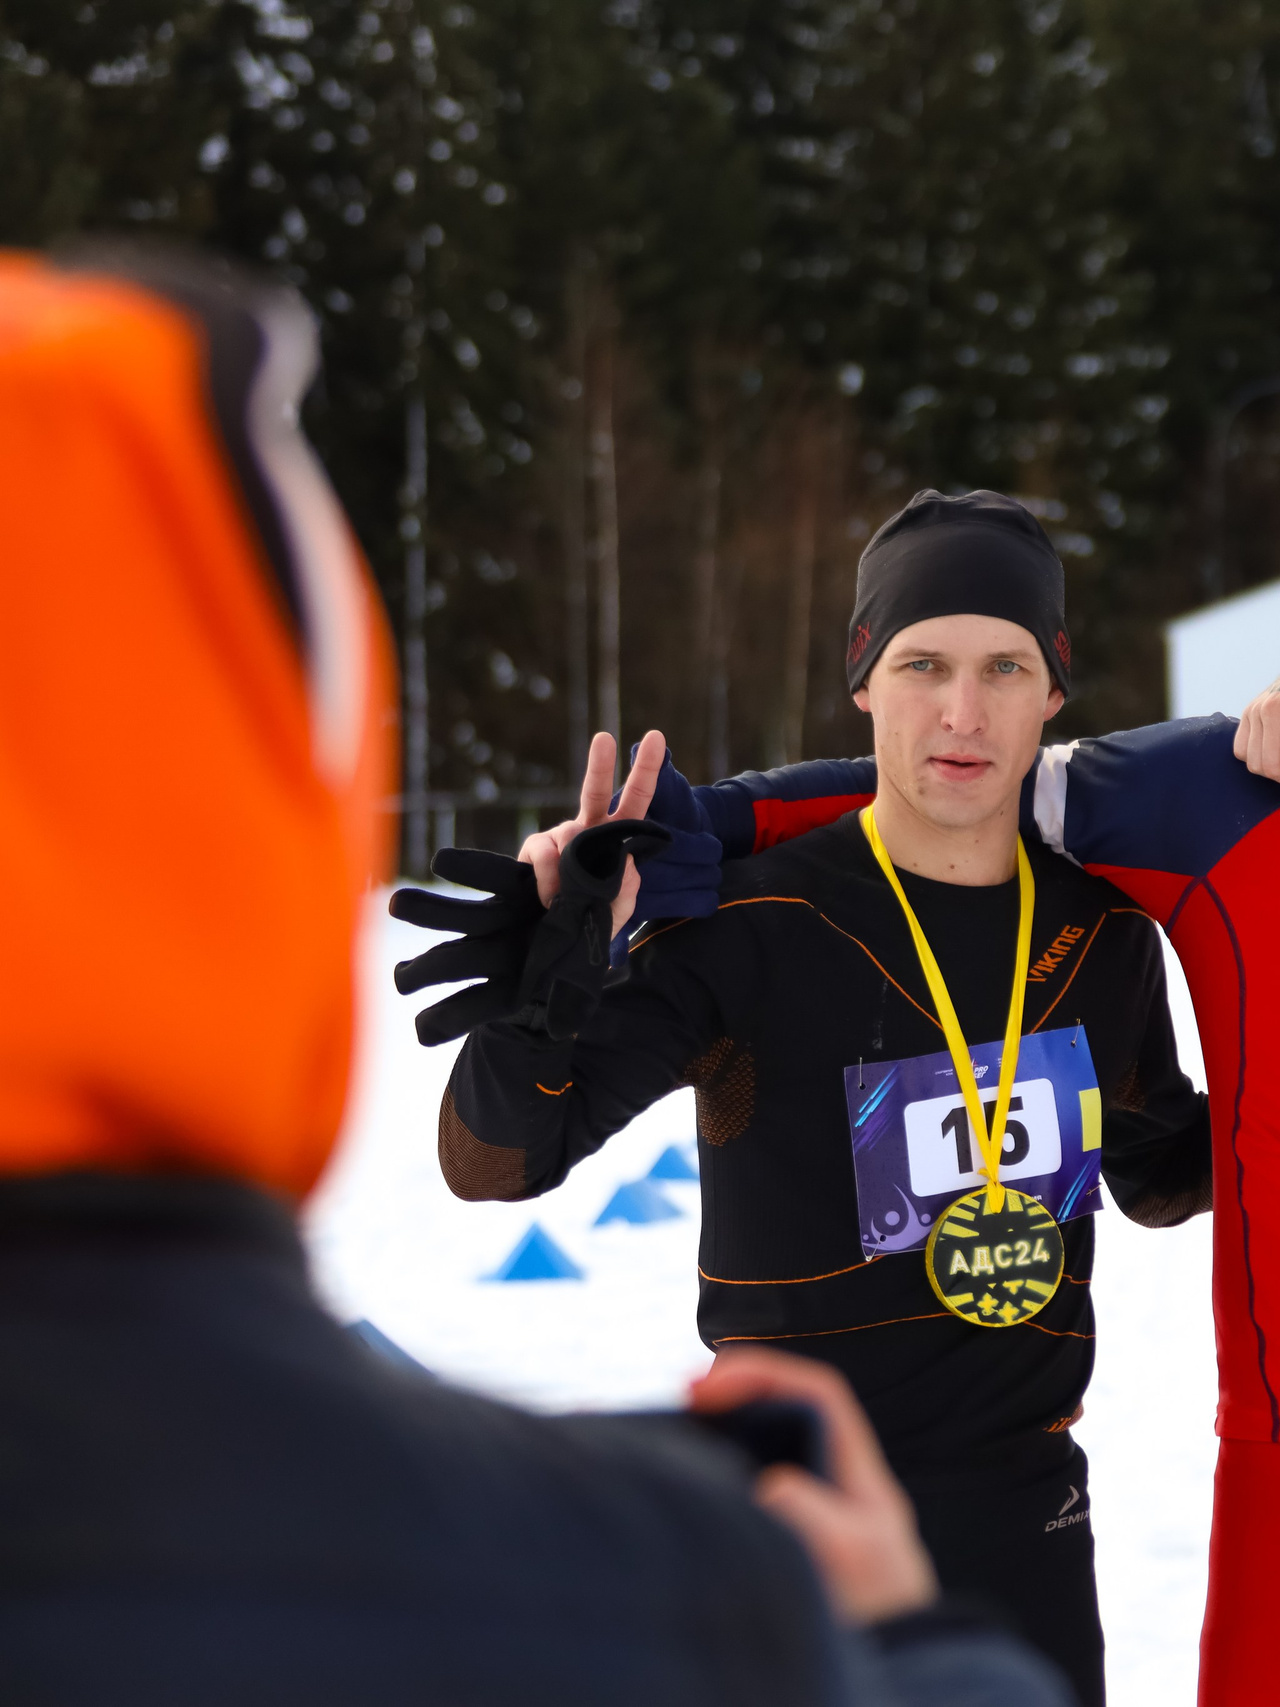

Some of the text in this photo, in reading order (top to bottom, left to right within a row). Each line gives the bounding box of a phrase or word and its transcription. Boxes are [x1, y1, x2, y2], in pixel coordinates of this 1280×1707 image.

[1027, 925, 1085, 982] VIKING
[941, 1096, 1031, 1175] 15
[950, 1238, 1050, 1277] АДС24
[1045, 1510, 1090, 1532] DEMIX
